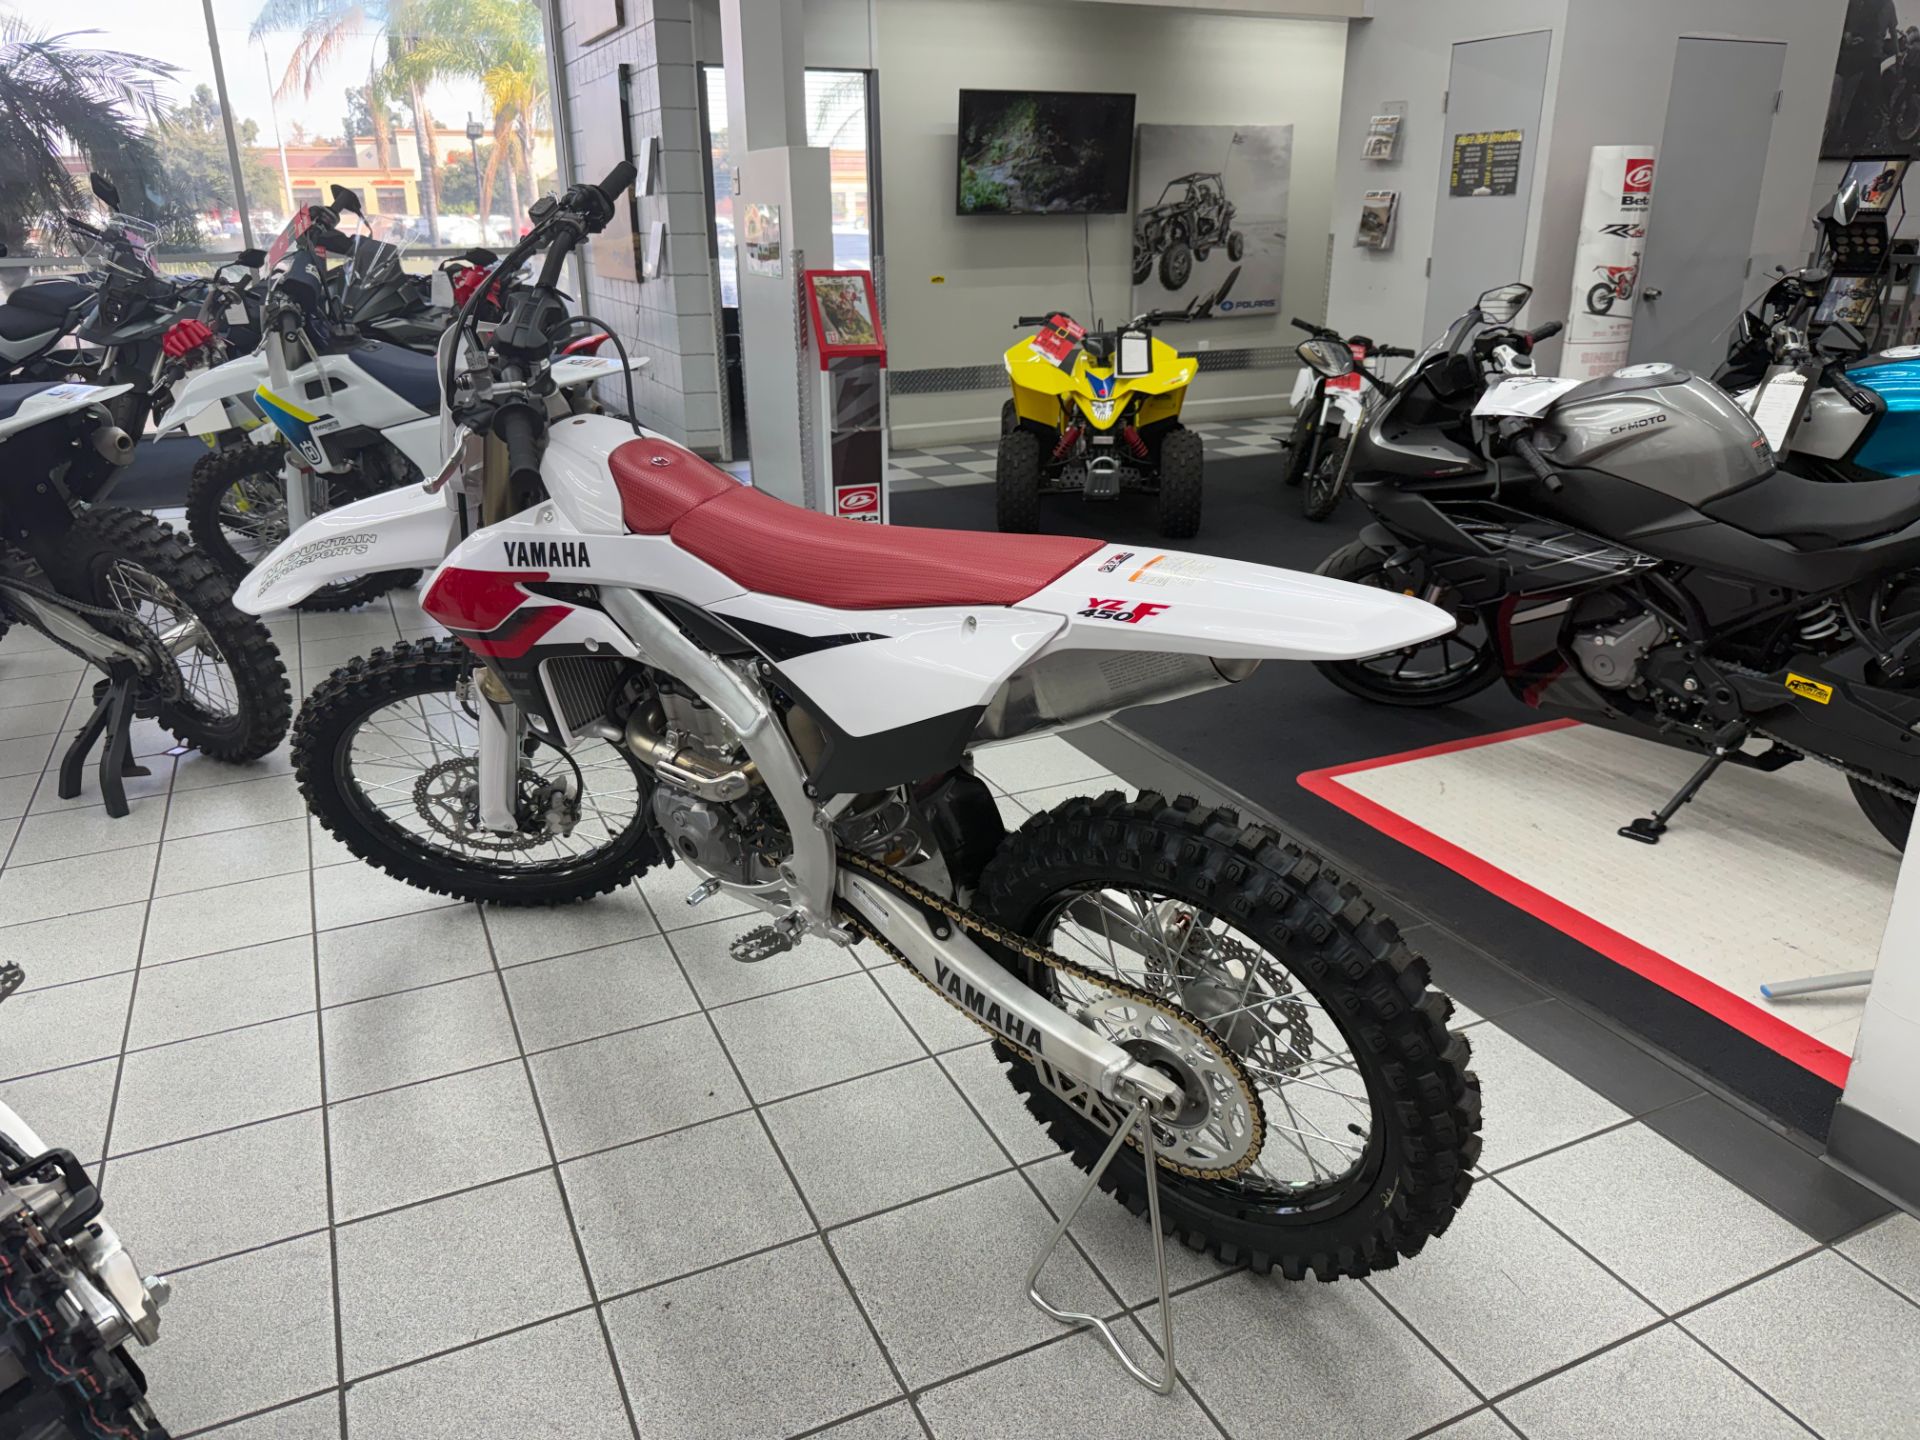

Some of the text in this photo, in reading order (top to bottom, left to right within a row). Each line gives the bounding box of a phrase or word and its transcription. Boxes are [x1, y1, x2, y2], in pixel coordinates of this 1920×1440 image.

[1621, 196, 1649, 205] Bet
[1235, 299, 1275, 309] POLARIS
[1609, 414, 1667, 435] CFMOTO
[260, 533, 378, 587] MOUNTAIN
[503, 541, 592, 568] YAMAHA
[257, 544, 370, 598] MOTORSPORTS
[1076, 608, 1135, 622] 450
[933, 956, 1044, 1055] YAMAHA
